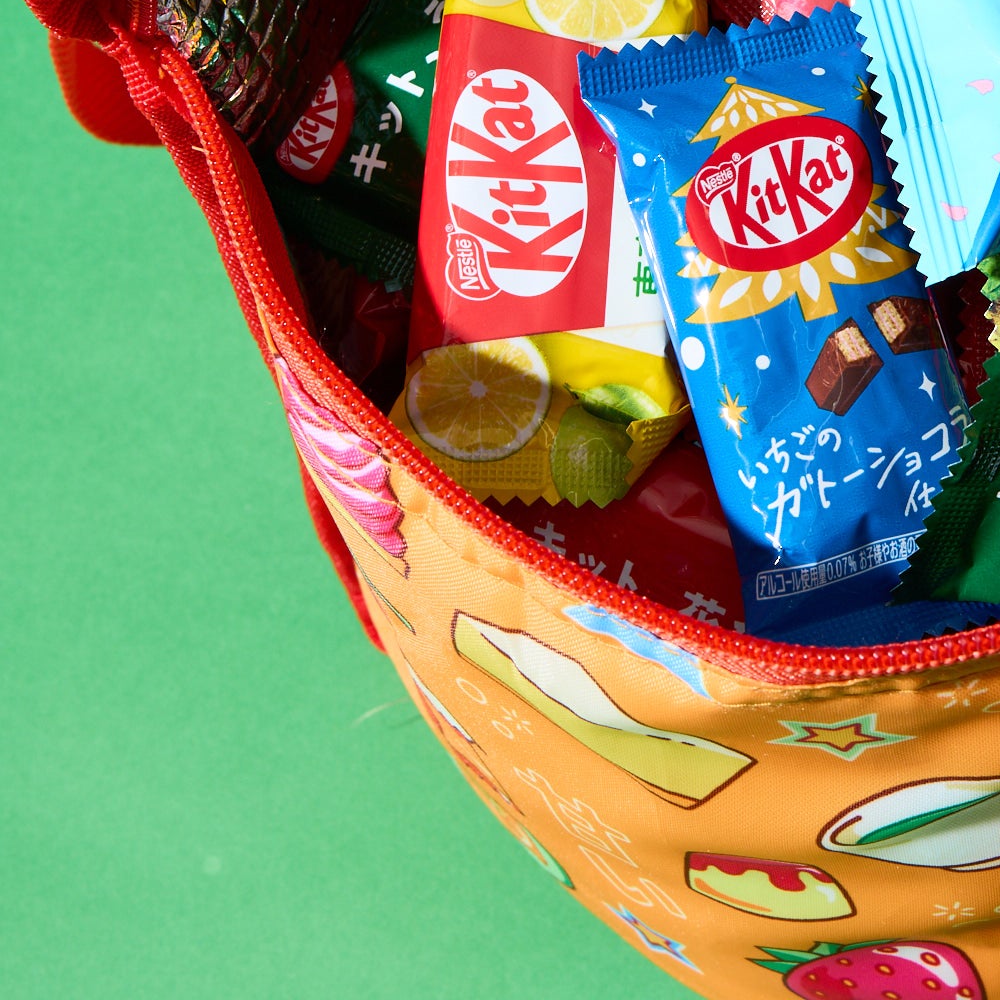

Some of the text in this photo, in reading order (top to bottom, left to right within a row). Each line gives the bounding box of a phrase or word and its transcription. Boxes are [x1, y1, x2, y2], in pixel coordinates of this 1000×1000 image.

[448, 76, 585, 274] KitKat
[721, 138, 848, 246] KitKat
[738, 424, 842, 490] いちごの
[858, 534, 922, 571] お子様やお酒の
